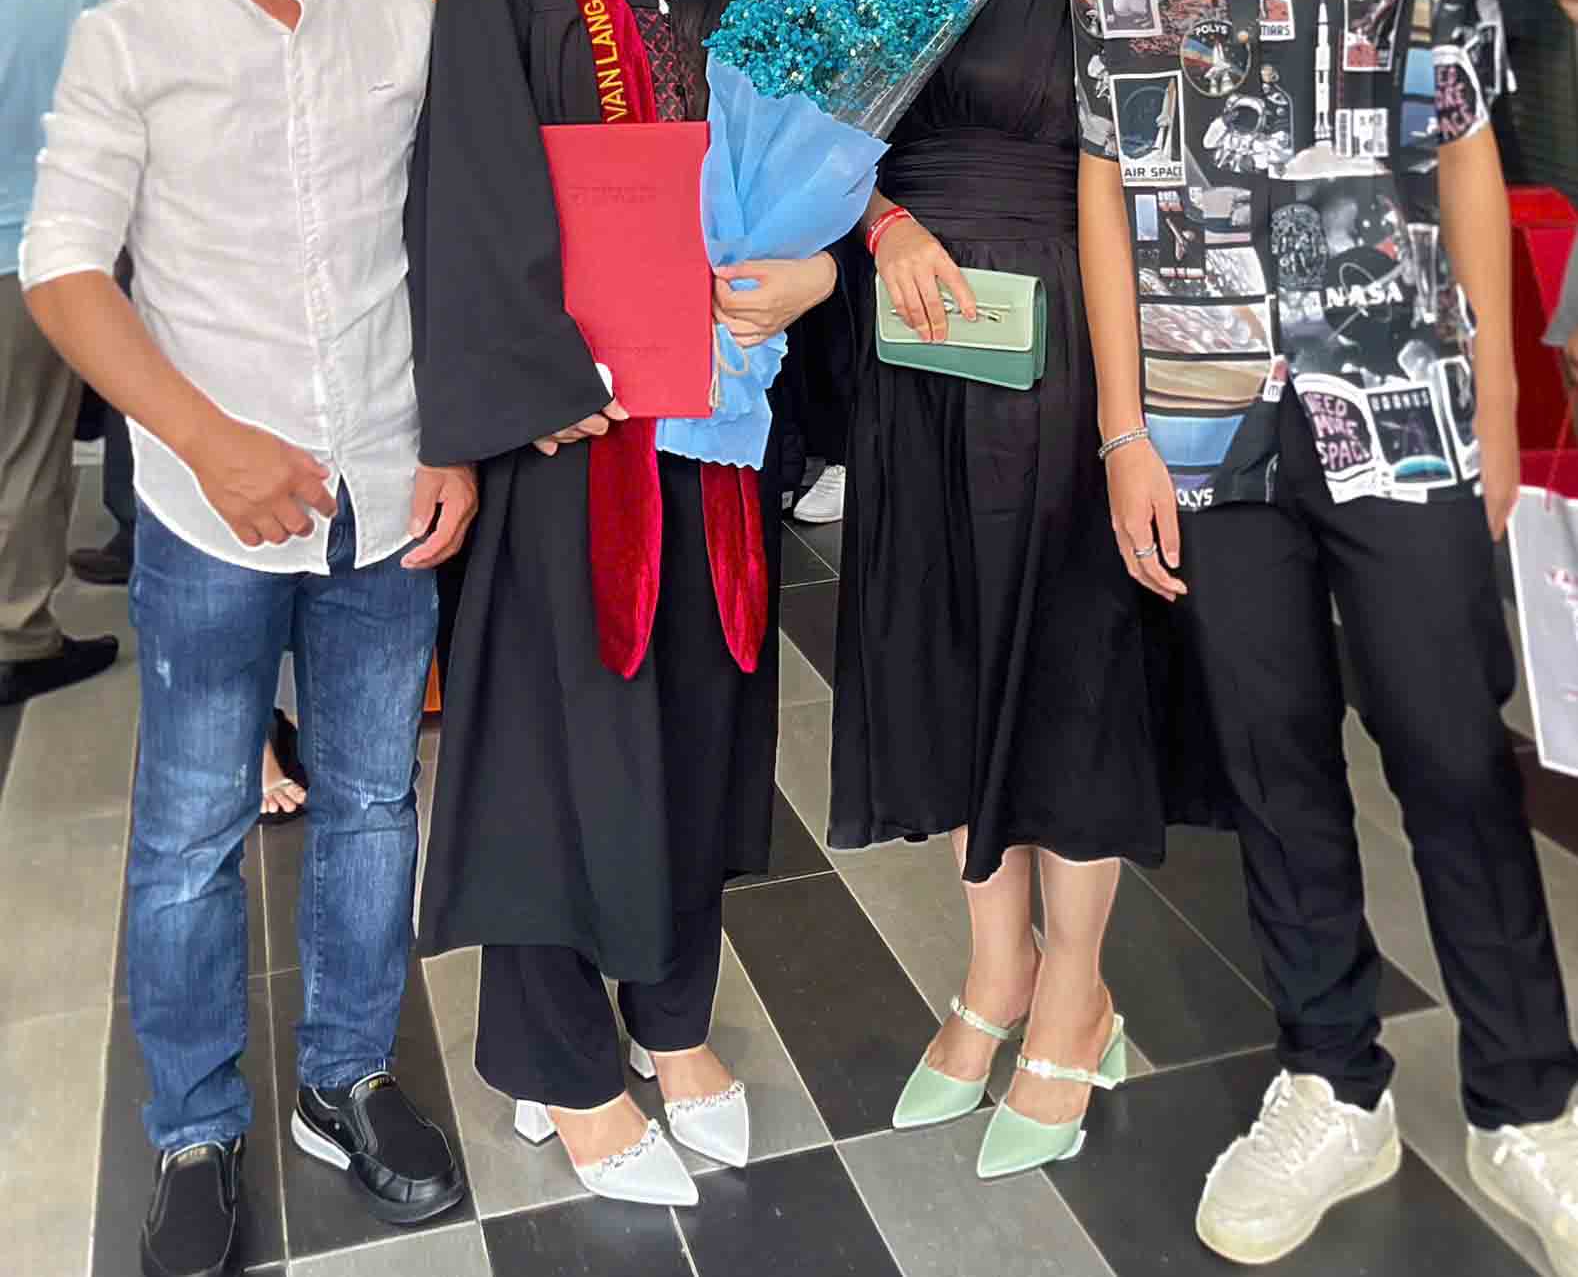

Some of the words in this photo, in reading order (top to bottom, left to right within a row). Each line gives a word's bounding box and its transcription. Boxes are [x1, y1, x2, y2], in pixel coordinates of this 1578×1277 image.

[598, 68, 628, 122] VAN
[1124, 166, 1146, 177] AIR
[1150, 165, 1183, 178] SPACE
[1325, 280, 1403, 308] NASA
[1176, 487, 1214, 508] OLYS
